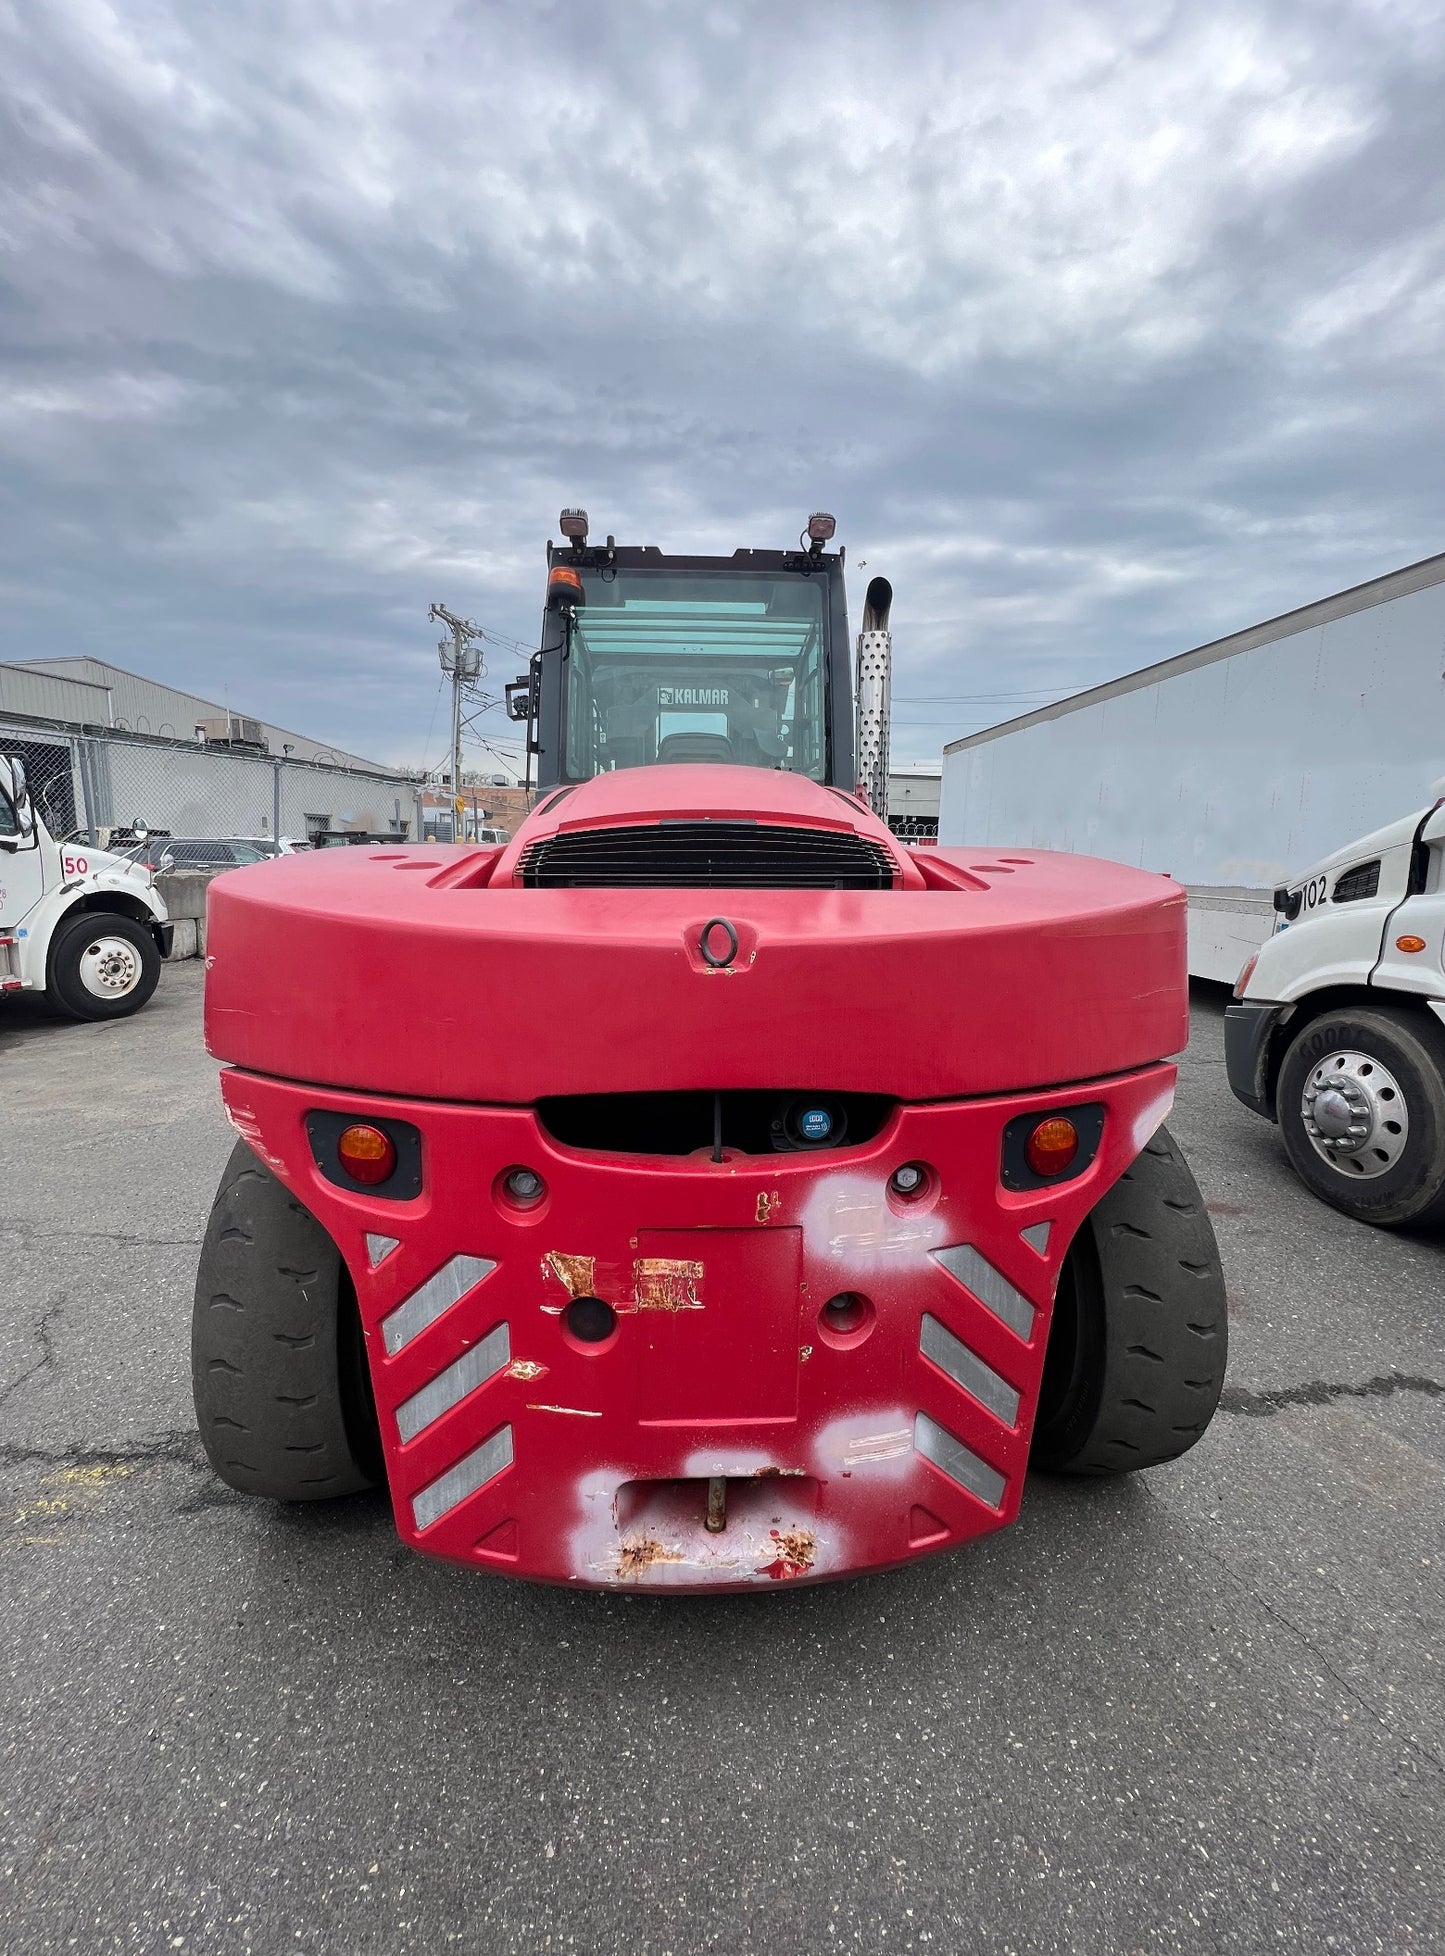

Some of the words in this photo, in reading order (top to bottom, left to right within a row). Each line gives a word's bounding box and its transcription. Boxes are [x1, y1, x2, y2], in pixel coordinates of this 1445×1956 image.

[674, 688, 729, 705] KALMAR
[65, 857, 88, 874] 50
[1303, 875, 1327, 911] 102
